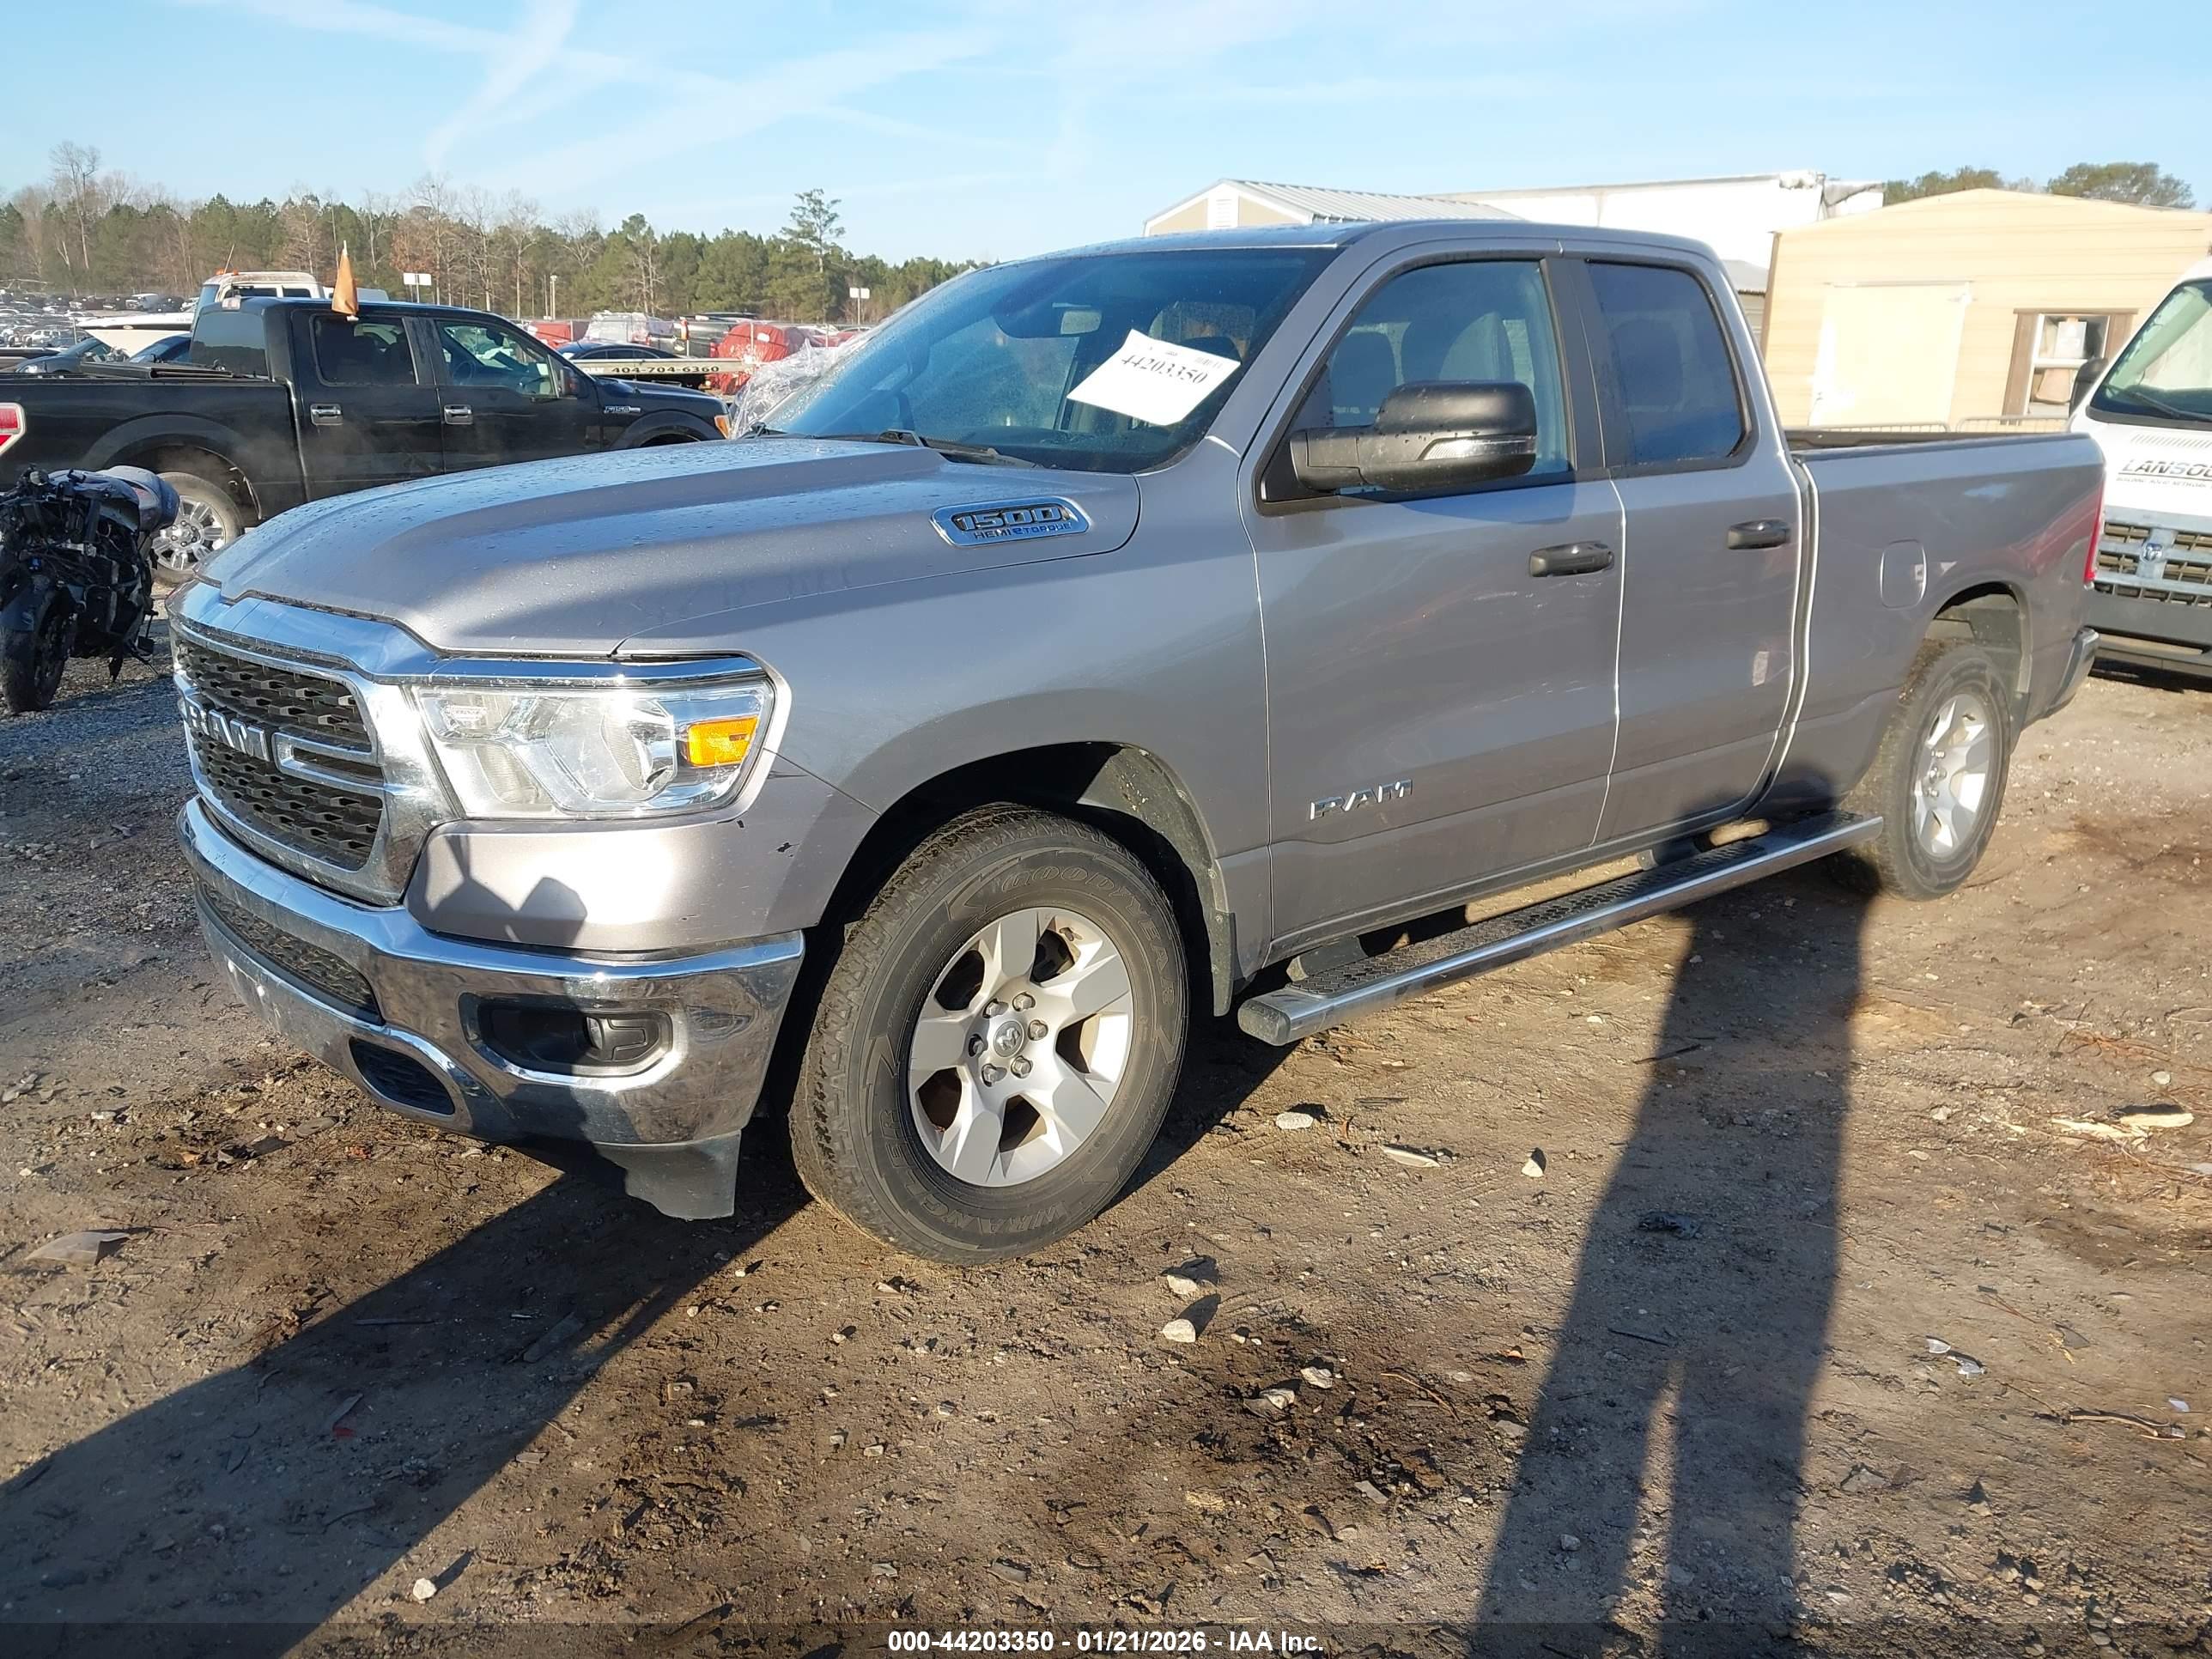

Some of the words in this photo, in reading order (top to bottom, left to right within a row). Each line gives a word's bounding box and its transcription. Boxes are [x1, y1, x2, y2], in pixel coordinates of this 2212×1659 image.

[611, 365, 720, 374] 404-704-6360
[1121, 355, 1208, 384] 44203350
[952, 506, 1065, 532] 1500
[974, 528, 1012, 539] HEMI
[184, 694, 270, 763] RAM
[1309, 778, 1413, 822] RAM
[1001, 865, 1178, 1006] GOODYEAR
